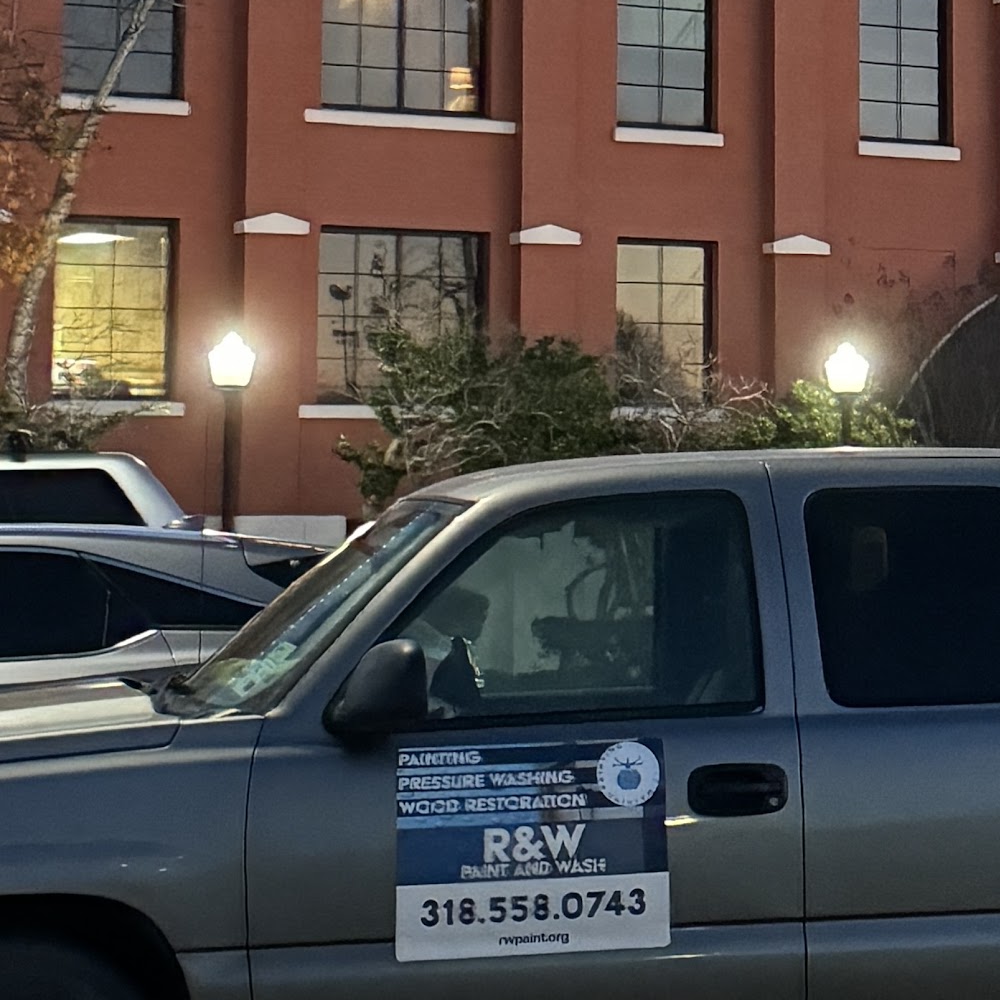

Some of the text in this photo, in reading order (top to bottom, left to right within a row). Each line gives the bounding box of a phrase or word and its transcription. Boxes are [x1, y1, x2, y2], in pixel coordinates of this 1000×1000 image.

[398, 750, 482, 767] PAINTING
[398, 769, 576, 791] PRESSURE WASHING
[399, 799, 460, 815] WOOD
[464, 793, 588, 813] RESTORATION
[482, 823, 587, 863] R&W
[460, 857, 607, 880] PAINT AND WASH
[420, 888, 647, 928] 318.558.0743
[498, 931, 570, 947] rwpaint.org
